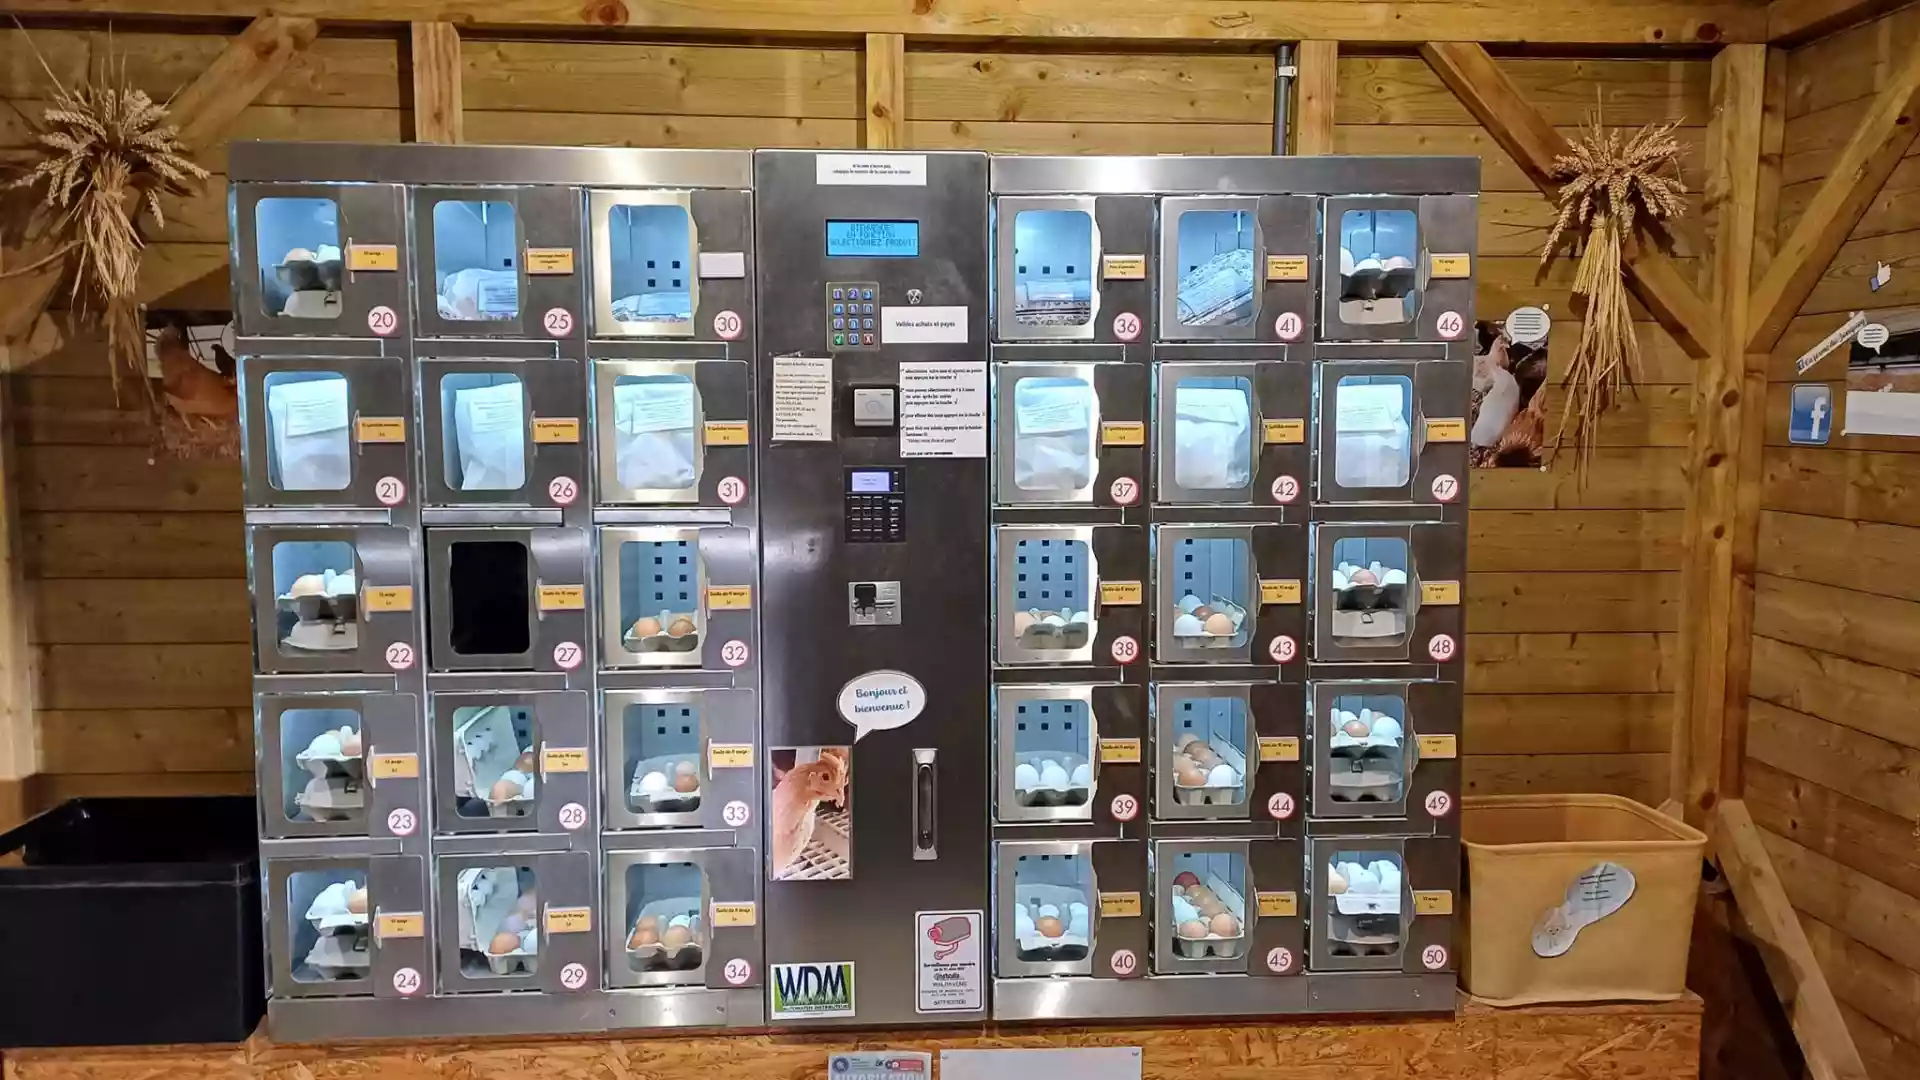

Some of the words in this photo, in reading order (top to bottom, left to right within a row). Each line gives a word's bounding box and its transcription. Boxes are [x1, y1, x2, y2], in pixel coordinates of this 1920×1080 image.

[371, 311, 394, 328] 20
[547, 313, 569, 330] 25
[717, 316, 739, 332] 30
[1117, 318, 1137, 334] 36
[1279, 318, 1295, 333] 41
[1439, 317, 1460, 332] 46
[380, 482, 398, 498] 21
[552, 482, 574, 498] 26
[722, 482, 738, 498] 31
[1114, 482, 1133, 498] 37
[1274, 481, 1295, 496] 42
[1434, 479, 1454, 495] 47
[557, 647, 578, 662] 27
[724, 645, 745, 661] 32
[1114, 641, 1135, 657] 38
[1272, 640, 1292, 656] 43
[1431, 639, 1451, 654] 48
[389, 647, 410, 664] 22
[856, 687, 897, 699] Bonjour
[898, 685, 909, 695] et
[854, 702, 905, 713] bienvenue
[1114, 799, 1135, 815] 39
[1271, 798, 1291, 813] 44
[1427, 795, 1448, 811] 49
[391, 814, 412, 829] 23
[562, 808, 582, 823] 28
[727, 806, 746, 821] 33
[1113, 953, 1134, 970] 40
[1269, 952, 1289, 967] 45
[1425, 948, 1445, 965] 50
[563, 968, 584, 983] 29
[727, 964, 747, 979] 34
[396, 973, 417, 988] 24
[774, 965, 848, 1003] WDM
